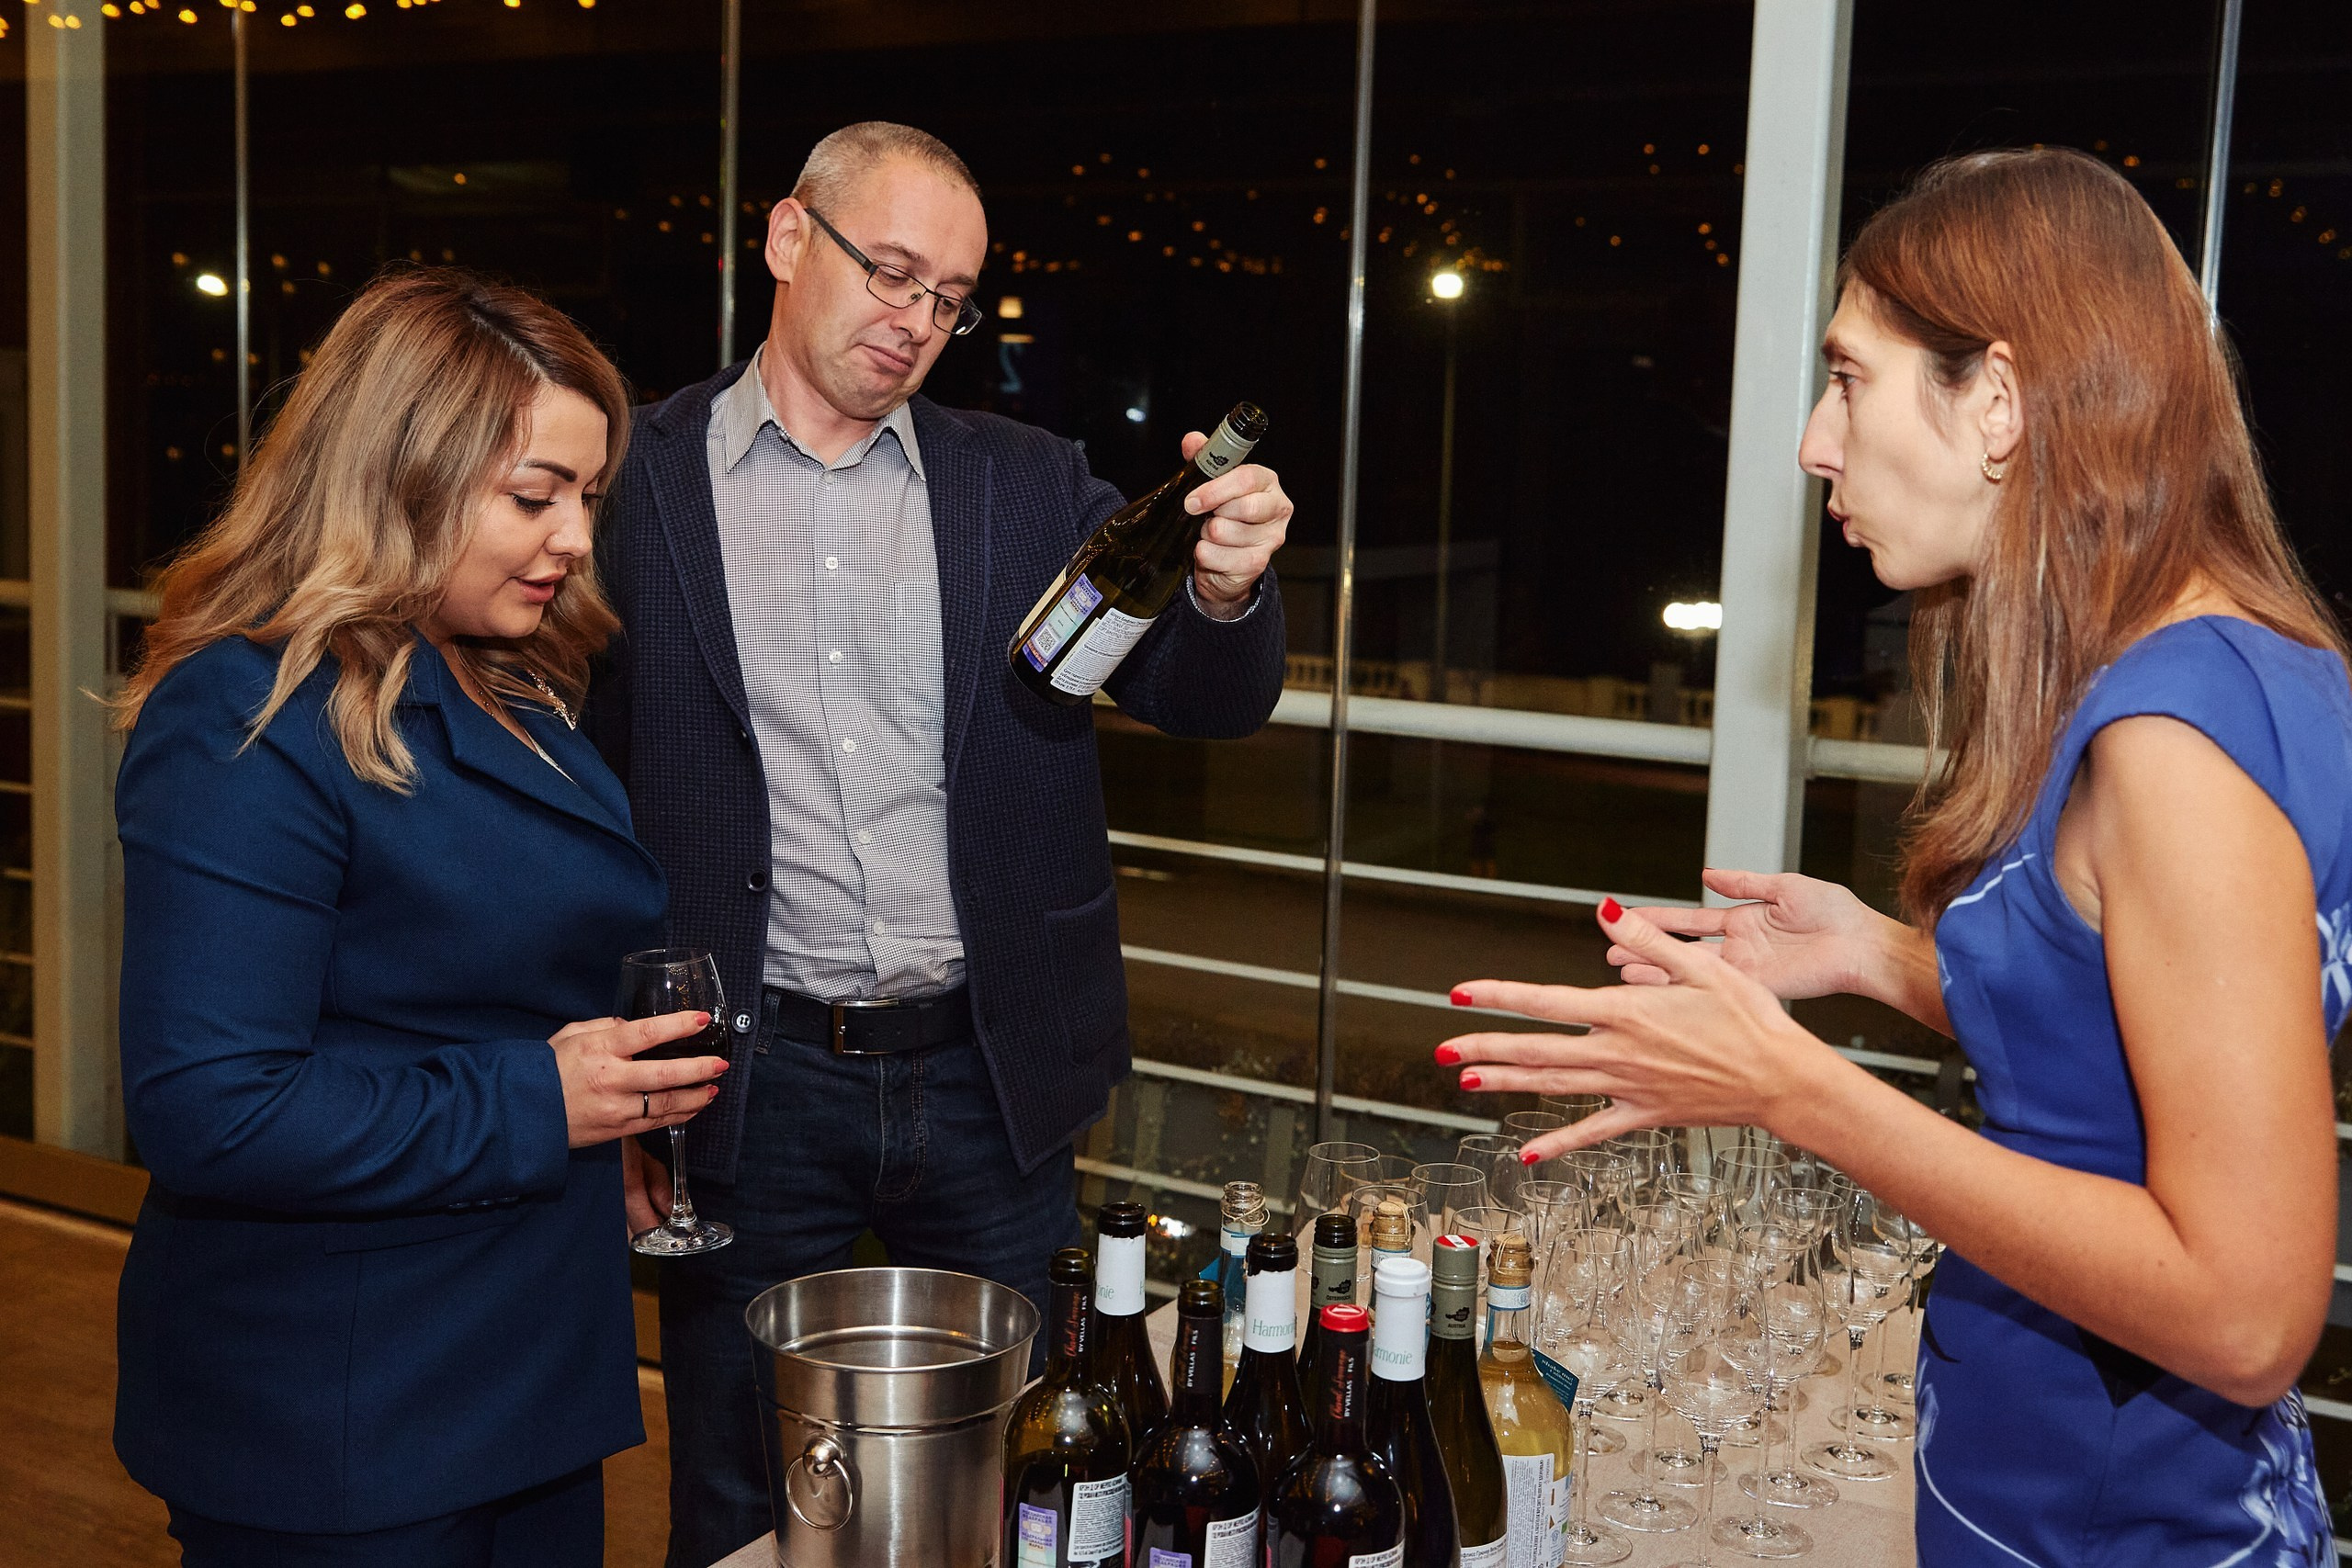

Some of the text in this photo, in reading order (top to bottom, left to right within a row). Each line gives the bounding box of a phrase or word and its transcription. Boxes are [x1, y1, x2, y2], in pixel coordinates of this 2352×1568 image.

[1191, 1329, 1199, 1345] FILS
[1078, 1343, 1084, 1353] BY
[1188, 1352, 1196, 1377] VELLAS
[1187, 1378, 1193, 1388] BY
[1344, 1407, 1351, 1417] BY
